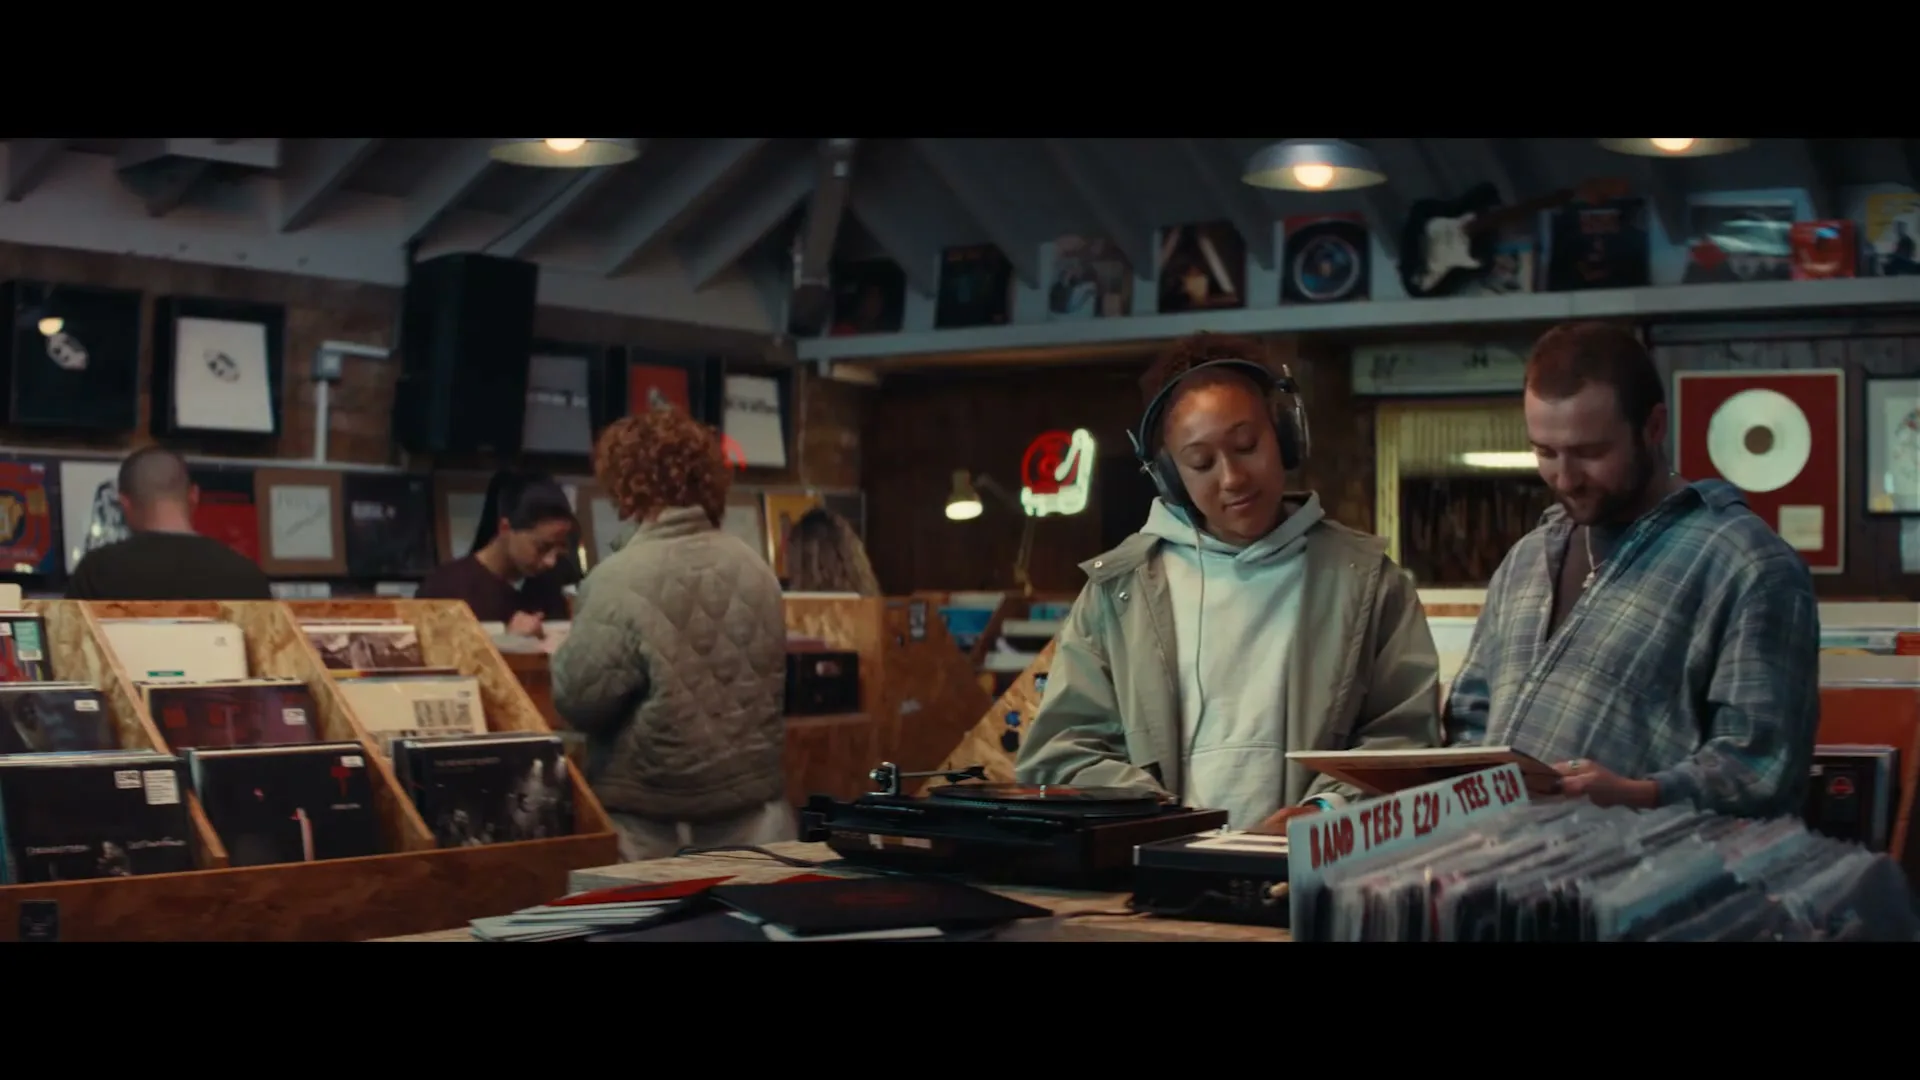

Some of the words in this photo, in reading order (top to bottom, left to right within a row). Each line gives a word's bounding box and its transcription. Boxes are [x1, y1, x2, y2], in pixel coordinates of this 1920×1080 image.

[1310, 816, 1354, 869] BAND
[1359, 799, 1403, 851] TEES
[1413, 791, 1440, 838] £20
[1452, 774, 1490, 814] TEES
[1492, 769, 1520, 806] £20
